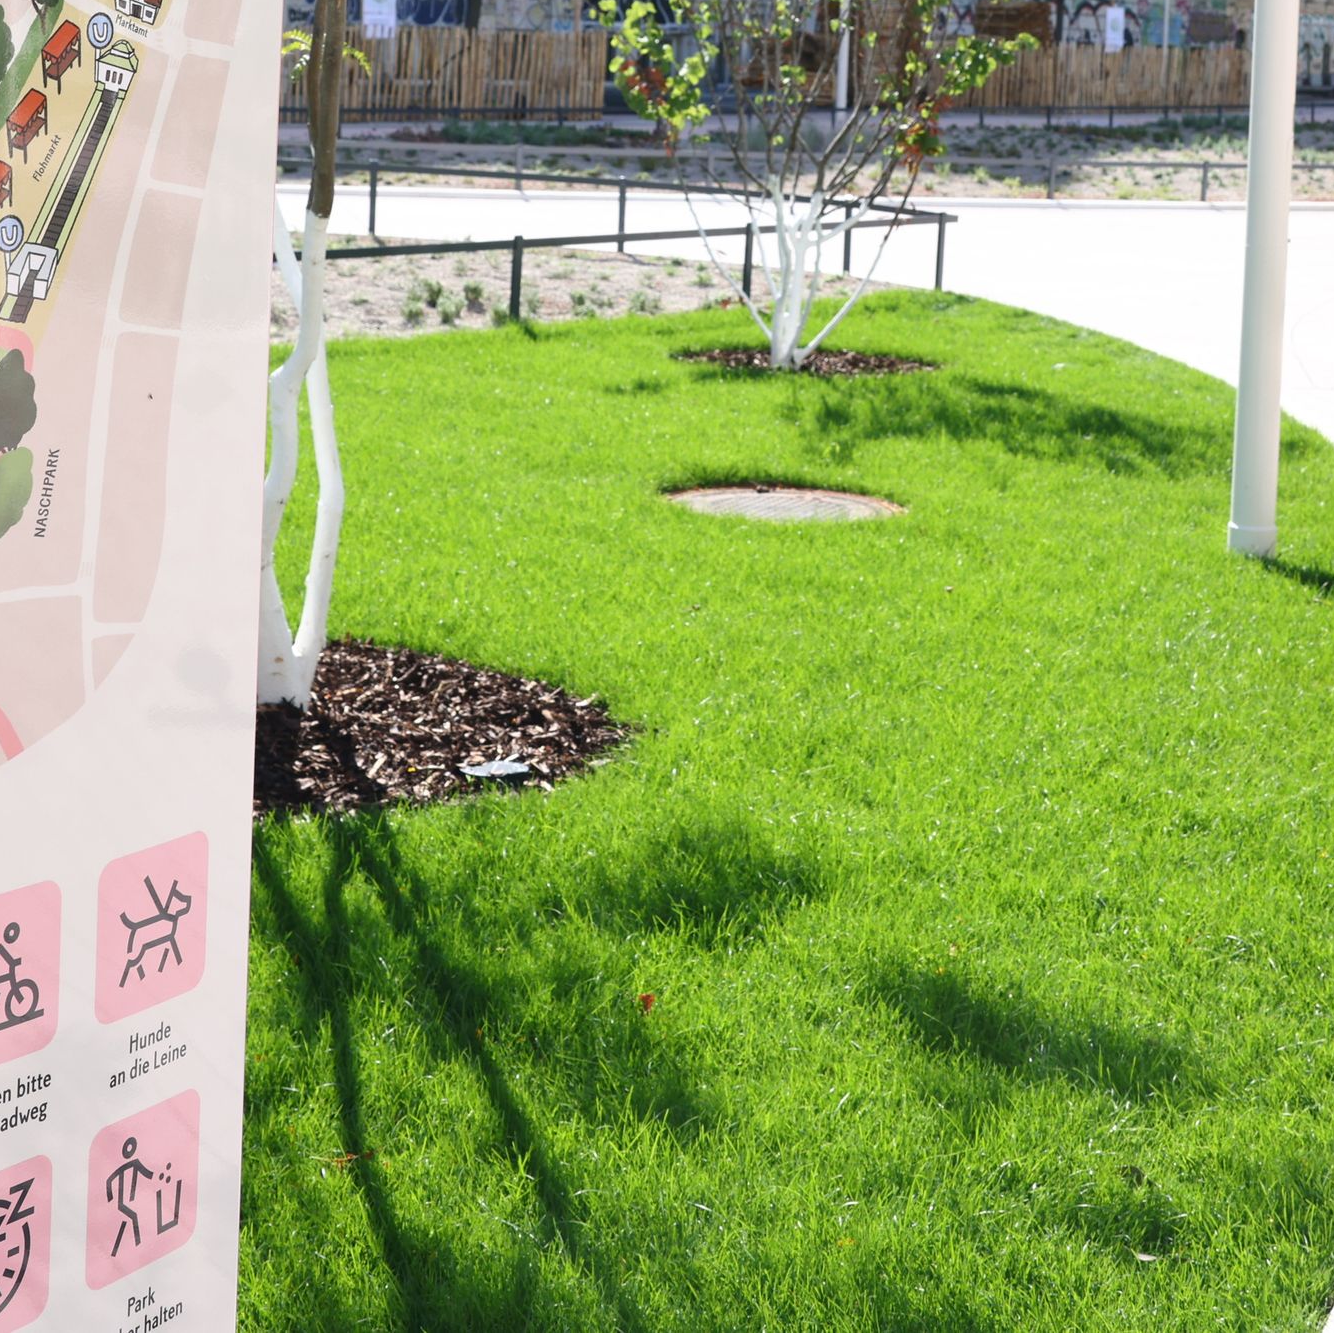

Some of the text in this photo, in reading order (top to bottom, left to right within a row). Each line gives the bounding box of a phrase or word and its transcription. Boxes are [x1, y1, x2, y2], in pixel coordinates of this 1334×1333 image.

[92, 23, 108, 43] U
[116, 14, 148, 38] Marktamt
[32, 134, 62, 183] Flohmarkt
[1, 225, 18, 246] U
[34, 448, 60, 538] NASCHPARK
[129, 1021, 171, 1054] Hunde
[109, 1044, 187, 1088] an die Leine
[16, 1072, 52, 1099] bitte
[127, 1286, 155, 1317] Park
[144, 1302, 183, 1333] halten
